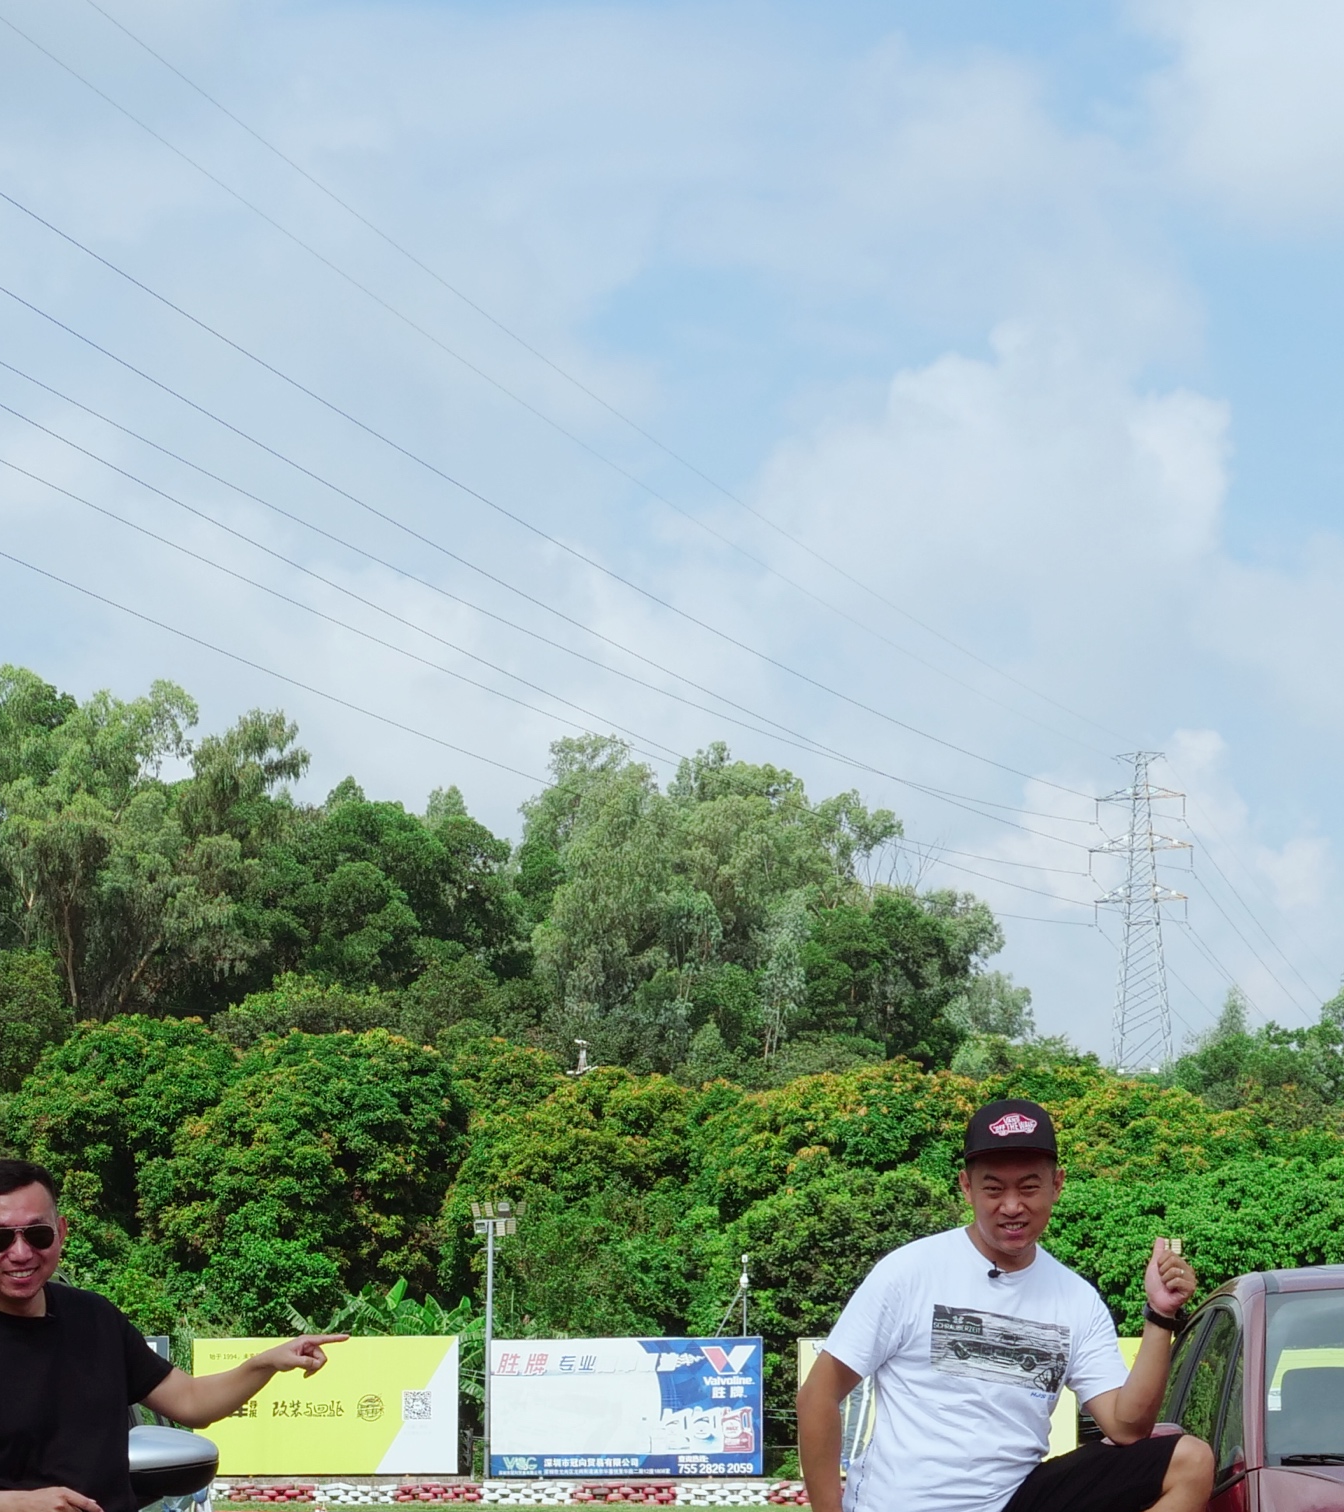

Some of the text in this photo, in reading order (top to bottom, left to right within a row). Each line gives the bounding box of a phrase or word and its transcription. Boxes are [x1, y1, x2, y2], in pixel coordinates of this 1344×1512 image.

[703, 1376, 753, 1386] Valvoline
[698, 1463, 725, 1475] 2826
[726, 1463, 754, 1474] 2059
